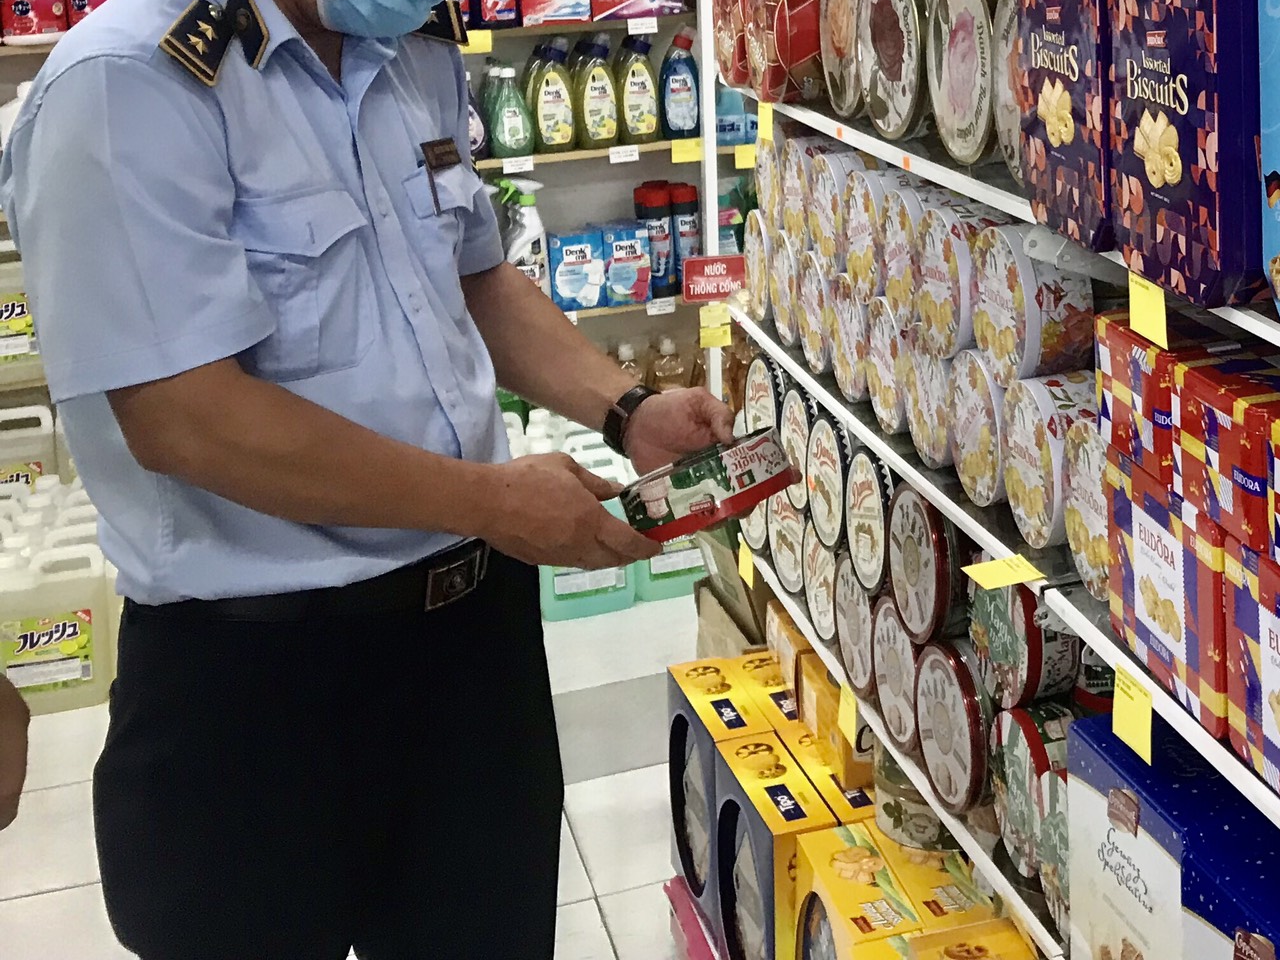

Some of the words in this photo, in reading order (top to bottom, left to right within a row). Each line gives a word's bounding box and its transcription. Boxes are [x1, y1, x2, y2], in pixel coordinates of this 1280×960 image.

[1030, 32, 1079, 82] Biscuits
[1141, 50, 1171, 76] Assorted
[1126, 58, 1189, 116] Biscuits
[565, 246, 586, 257] Denk
[615, 241, 636, 253] Denk
[689, 281, 717, 294] THÔNG
[731, 450, 766, 473] Magic
[1233, 468, 1260, 492] EUDORA
[15, 621, 81, 656] フレッシュ
